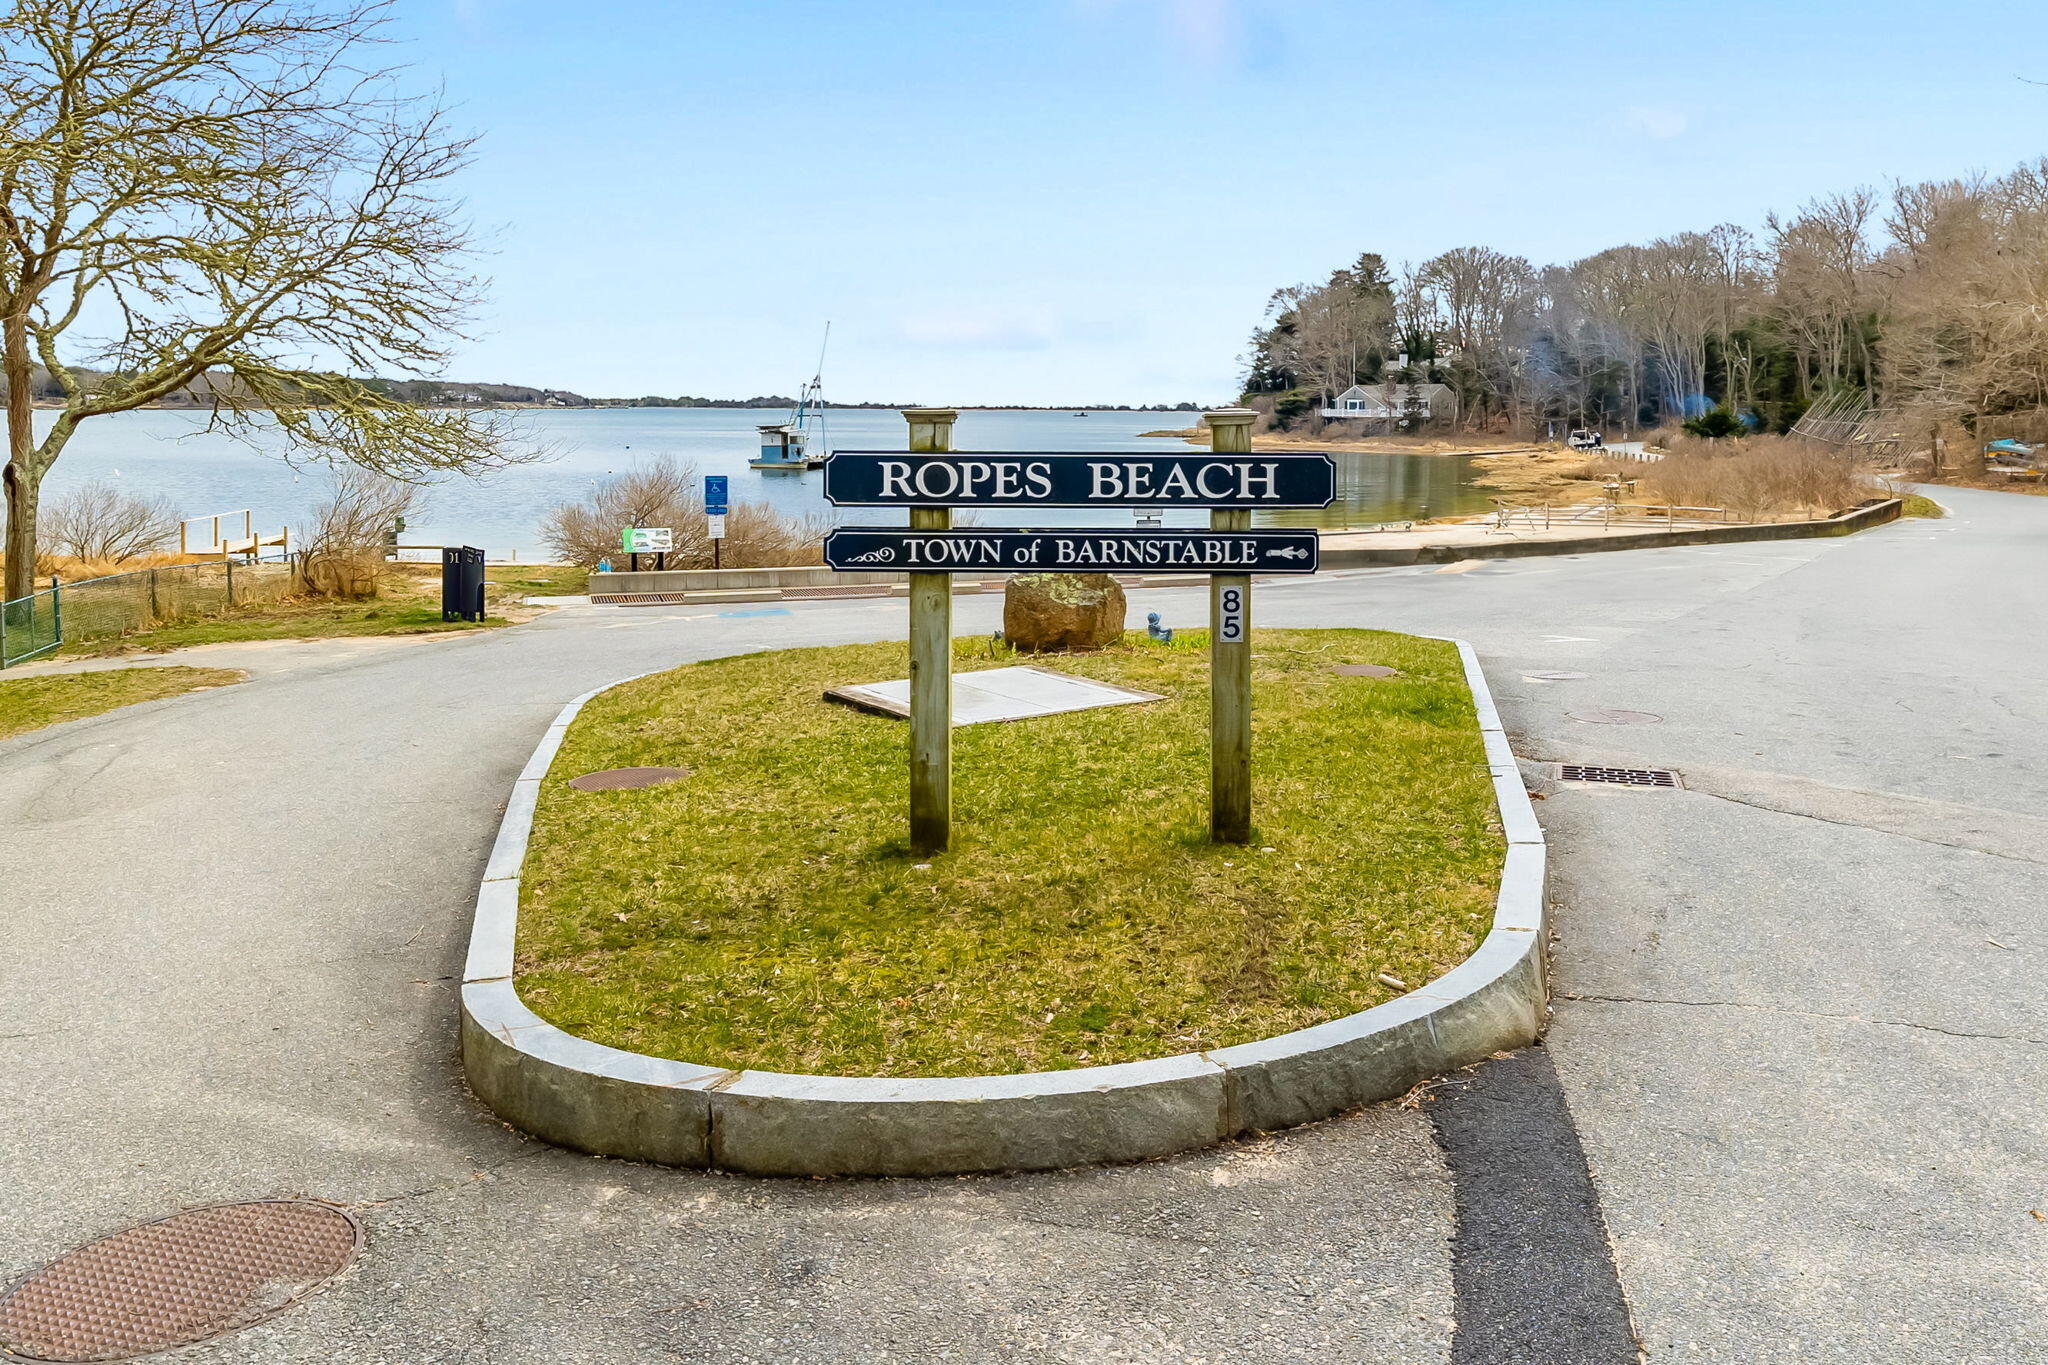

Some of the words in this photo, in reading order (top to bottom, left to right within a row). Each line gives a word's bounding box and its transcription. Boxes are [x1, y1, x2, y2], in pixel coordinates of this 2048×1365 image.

[878, 461, 1051, 498] ROPES
[1087, 462, 1280, 499] BEACH
[903, 539, 1002, 563] TOWN
[1014, 539, 1041, 563] of
[1056, 540, 1258, 564] BARNSTABLE
[1223, 590, 1240, 638] 85
